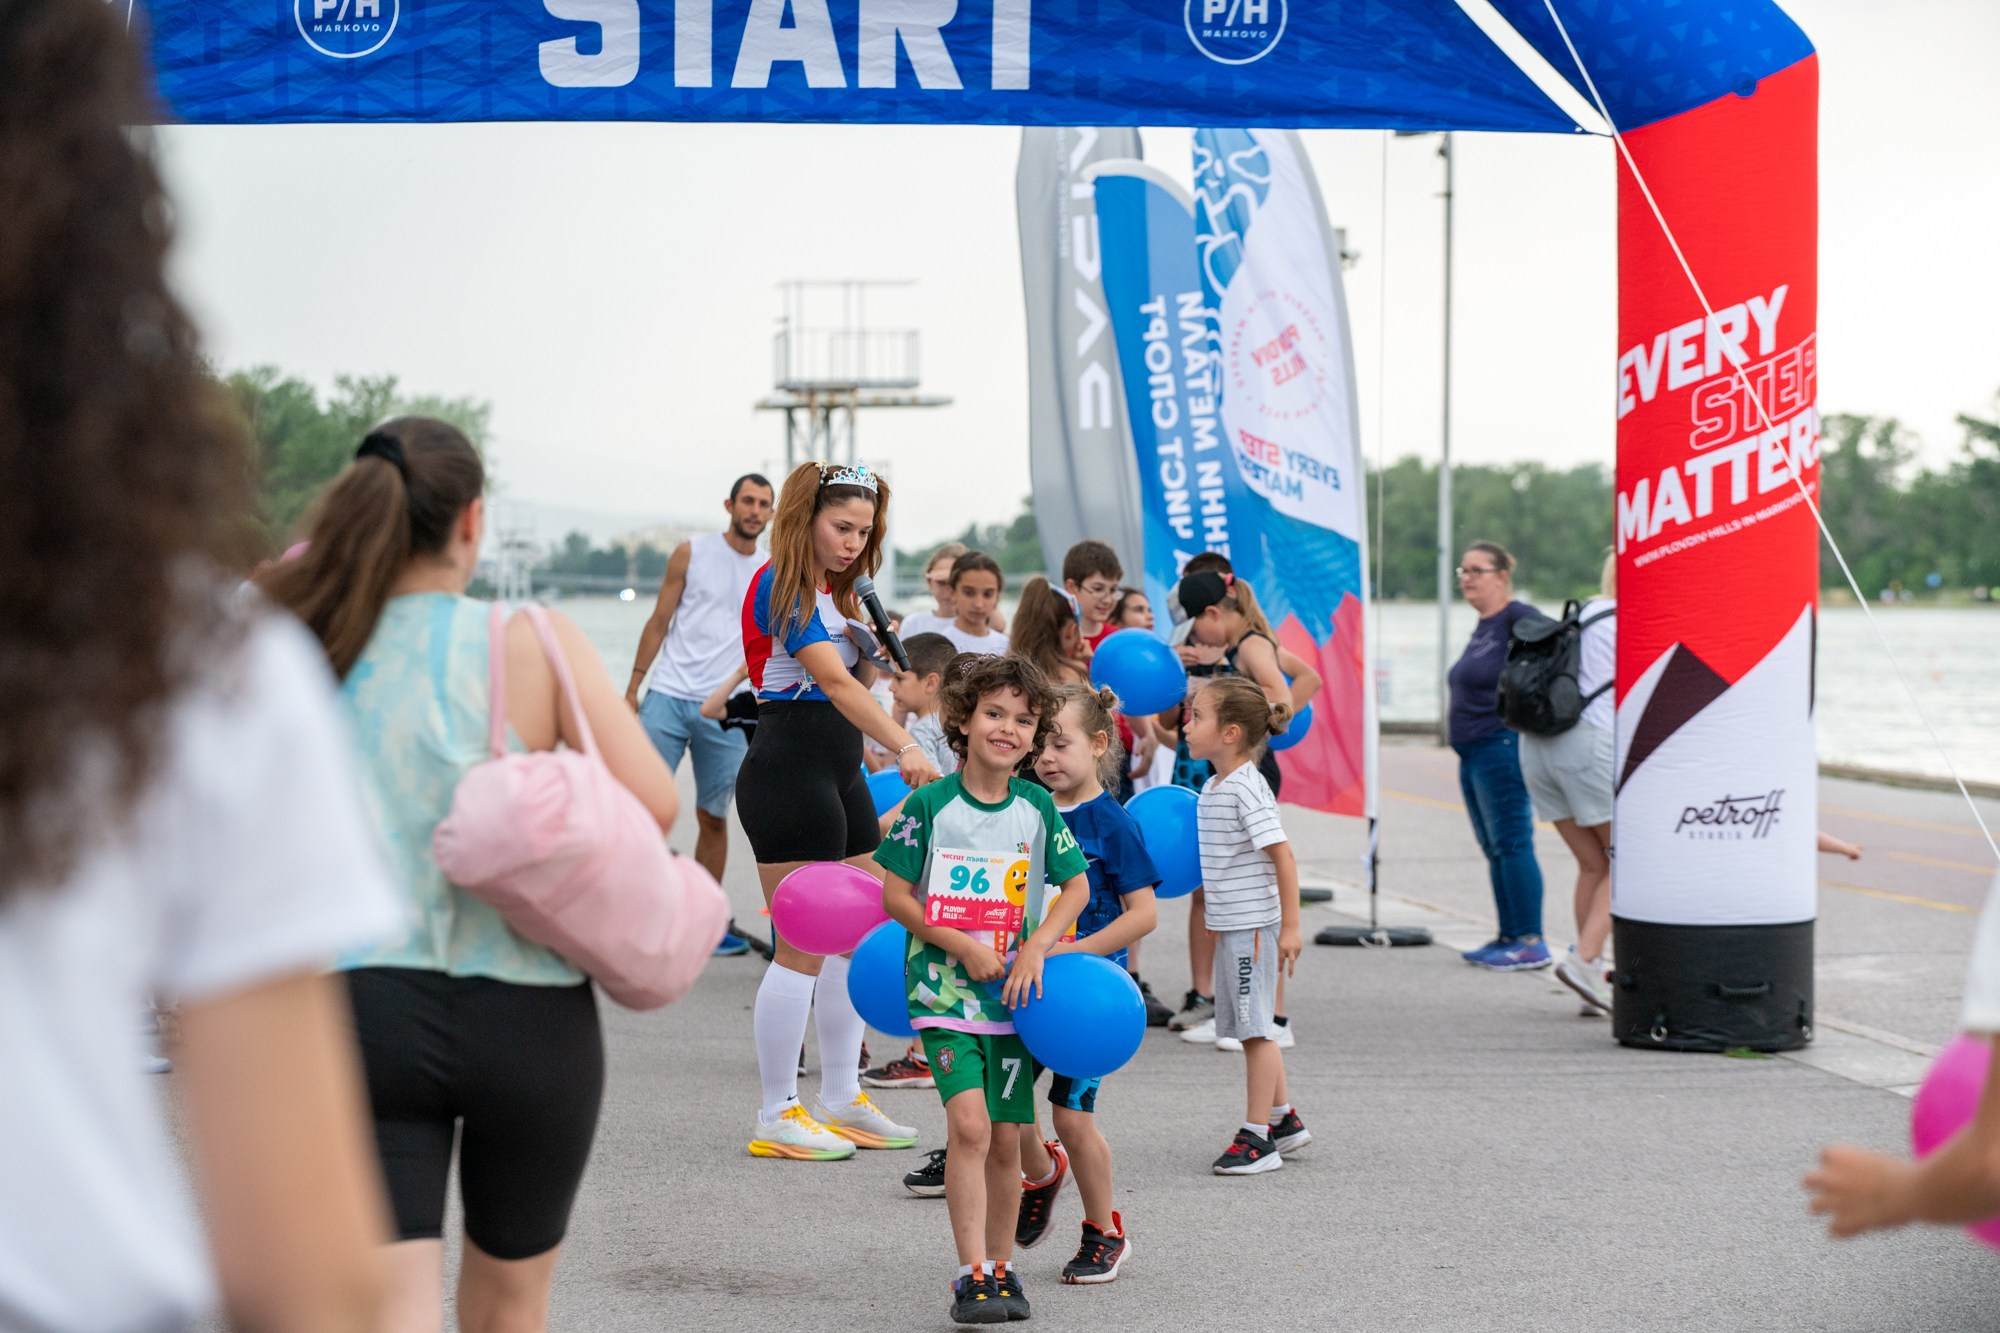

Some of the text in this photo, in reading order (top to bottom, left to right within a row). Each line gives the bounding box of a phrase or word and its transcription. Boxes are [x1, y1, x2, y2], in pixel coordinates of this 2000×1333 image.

[313, 23, 380, 33] MARKOVO
[1202, 29, 1268, 39] MARKOVO
[1617, 284, 1789, 421] EVERY
[1690, 332, 1817, 451] STEP
[949, 864, 991, 895] 96
[1238, 956, 1252, 995] ROAD
[1001, 1057, 1022, 1101] 7
